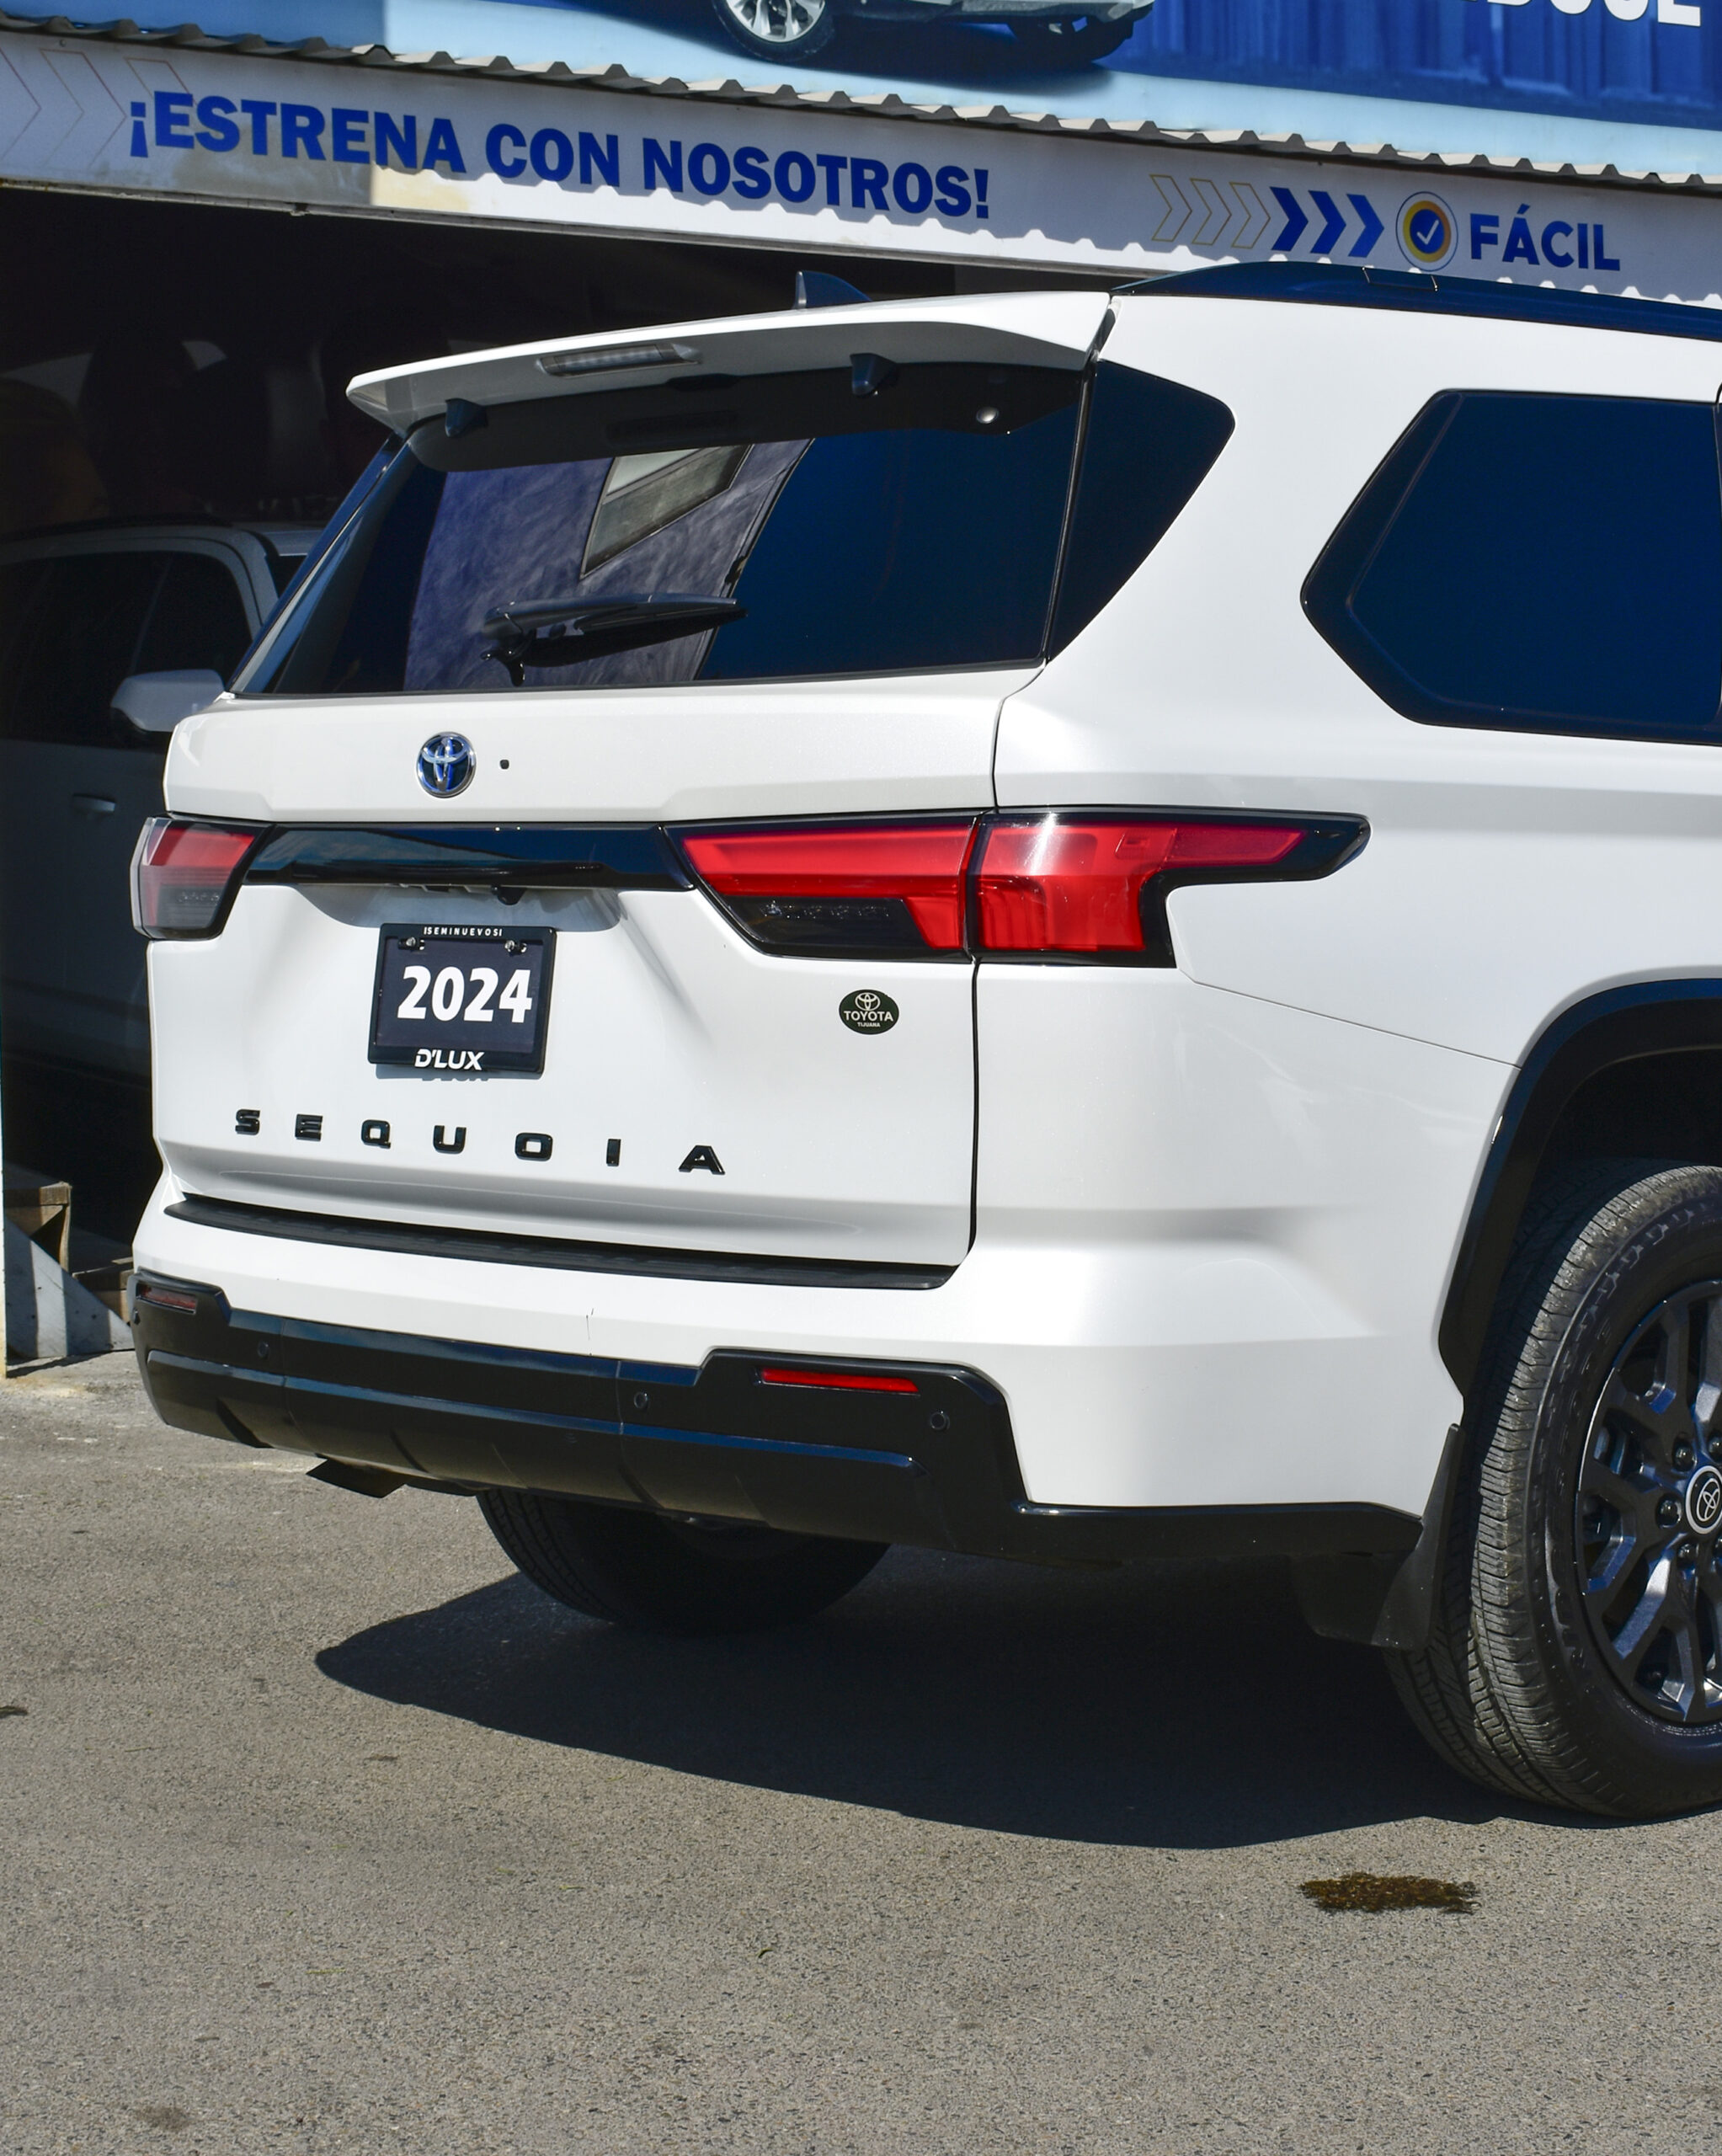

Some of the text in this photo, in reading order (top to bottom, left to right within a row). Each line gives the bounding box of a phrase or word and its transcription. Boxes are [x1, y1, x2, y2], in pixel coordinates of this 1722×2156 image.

[130, 90, 990, 219] ¡ESTRENA CON NOSOTROS!
[1469, 204, 1622, 271] FÁCIL
[397, 965, 533, 1023] 2024
[843, 1011, 894, 1022] TOYOTA
[413, 1048, 486, 1071] D'LUX
[234, 1107, 727, 1177] SEQUOIA
